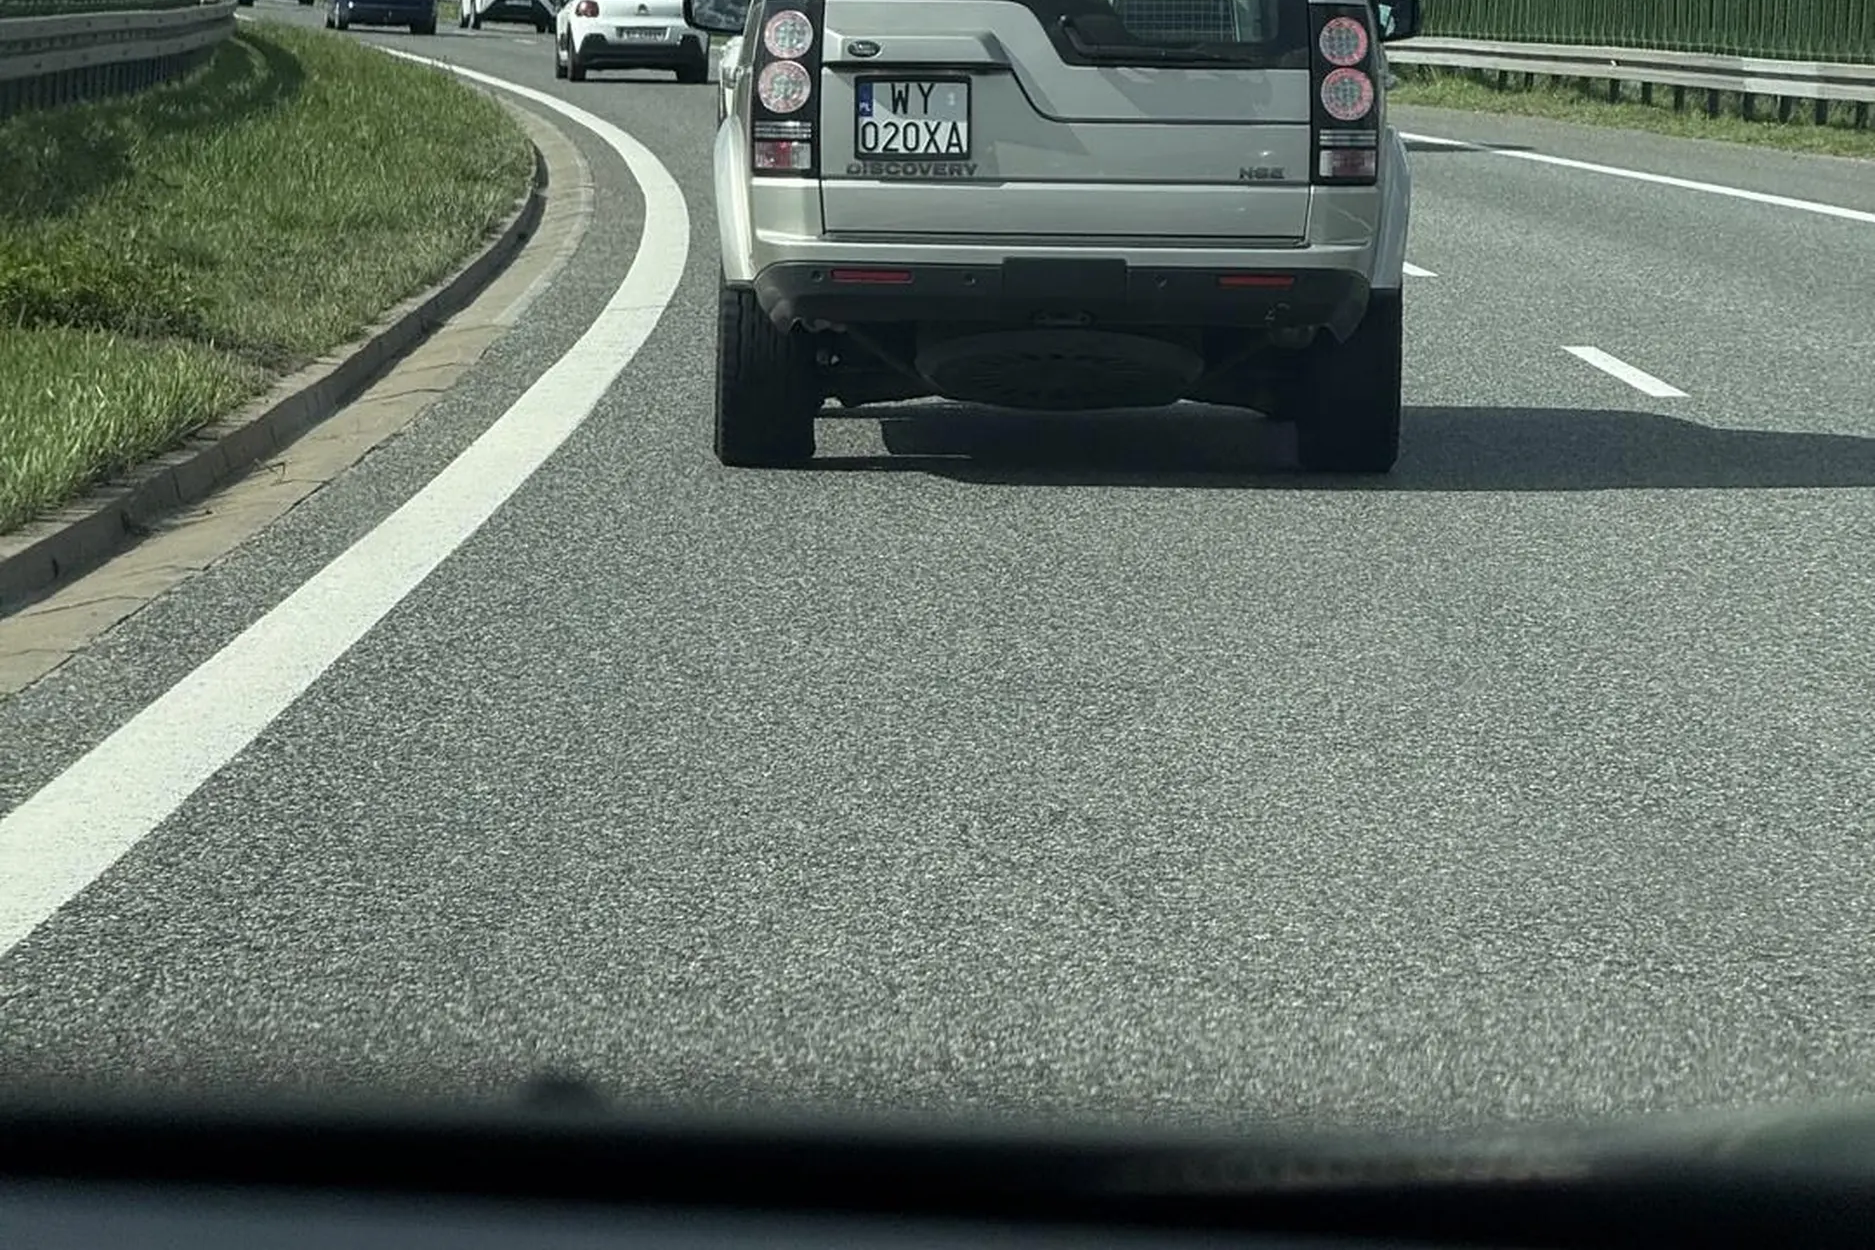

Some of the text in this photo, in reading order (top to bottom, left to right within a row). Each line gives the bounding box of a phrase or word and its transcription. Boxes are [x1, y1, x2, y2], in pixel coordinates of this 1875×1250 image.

[891, 83, 935, 115] WY
[861, 121, 964, 153] 020XA
[847, 162, 979, 177] DISCOVERY
